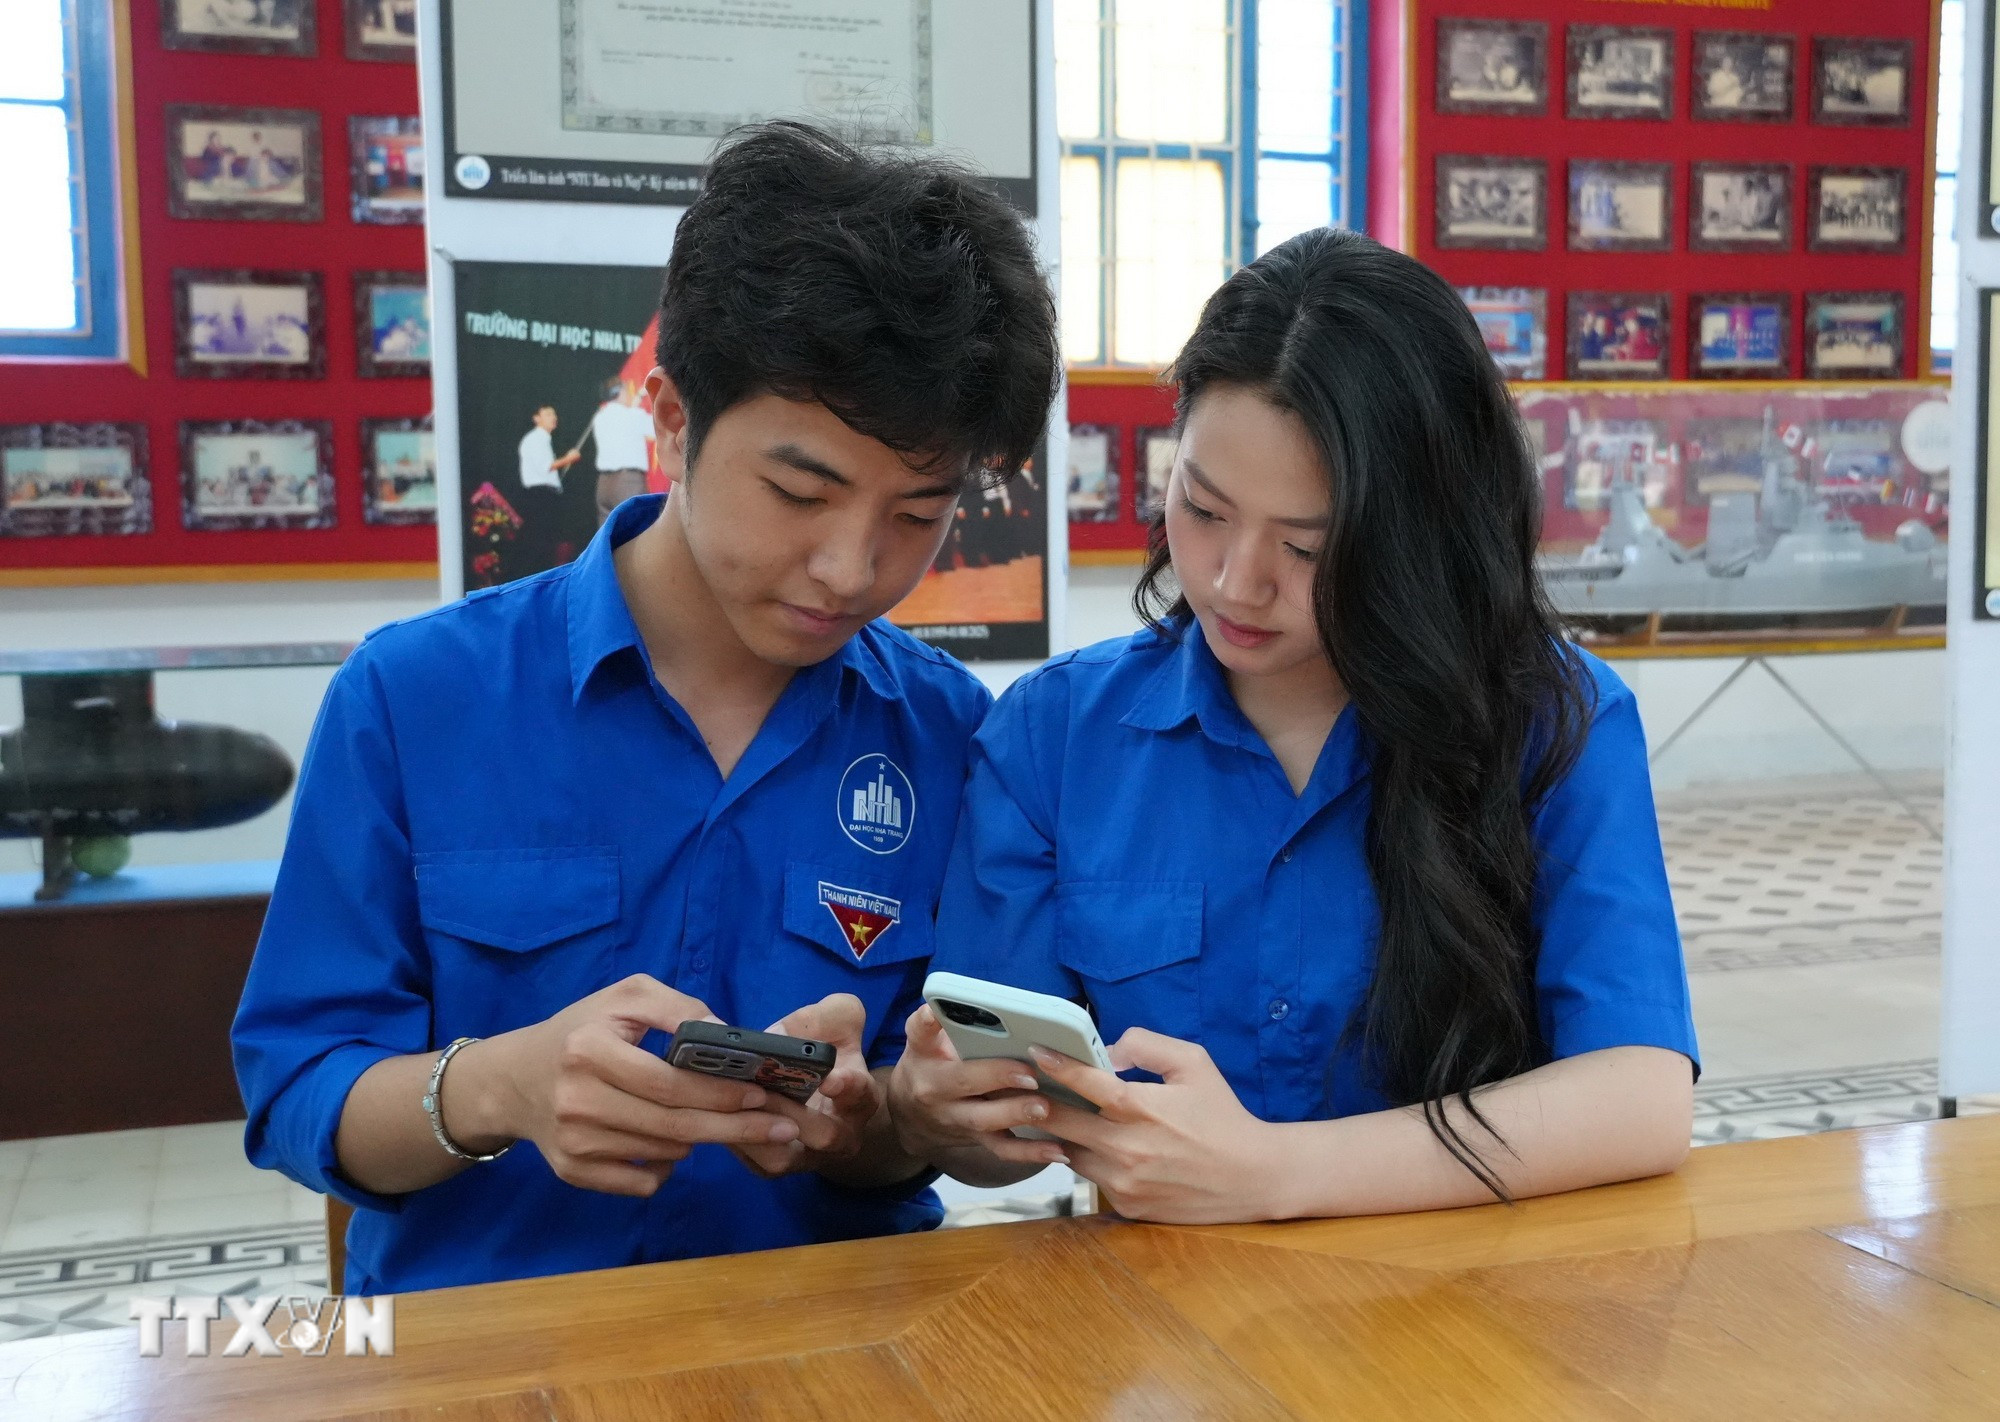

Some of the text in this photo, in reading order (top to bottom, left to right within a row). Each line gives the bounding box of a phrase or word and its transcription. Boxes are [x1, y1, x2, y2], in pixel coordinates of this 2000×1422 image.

[466, 310, 528, 340] TRƯỜNG
[531, 321, 557, 347] ĐẠI
[560, 324, 591, 351] HỌC
[593, 330, 623, 352] NHA
[849, 824, 904, 839] ĐẠI HỌC NHA TRANG
[822, 888, 897, 918] THANH NIÊN VIỆT NAM
